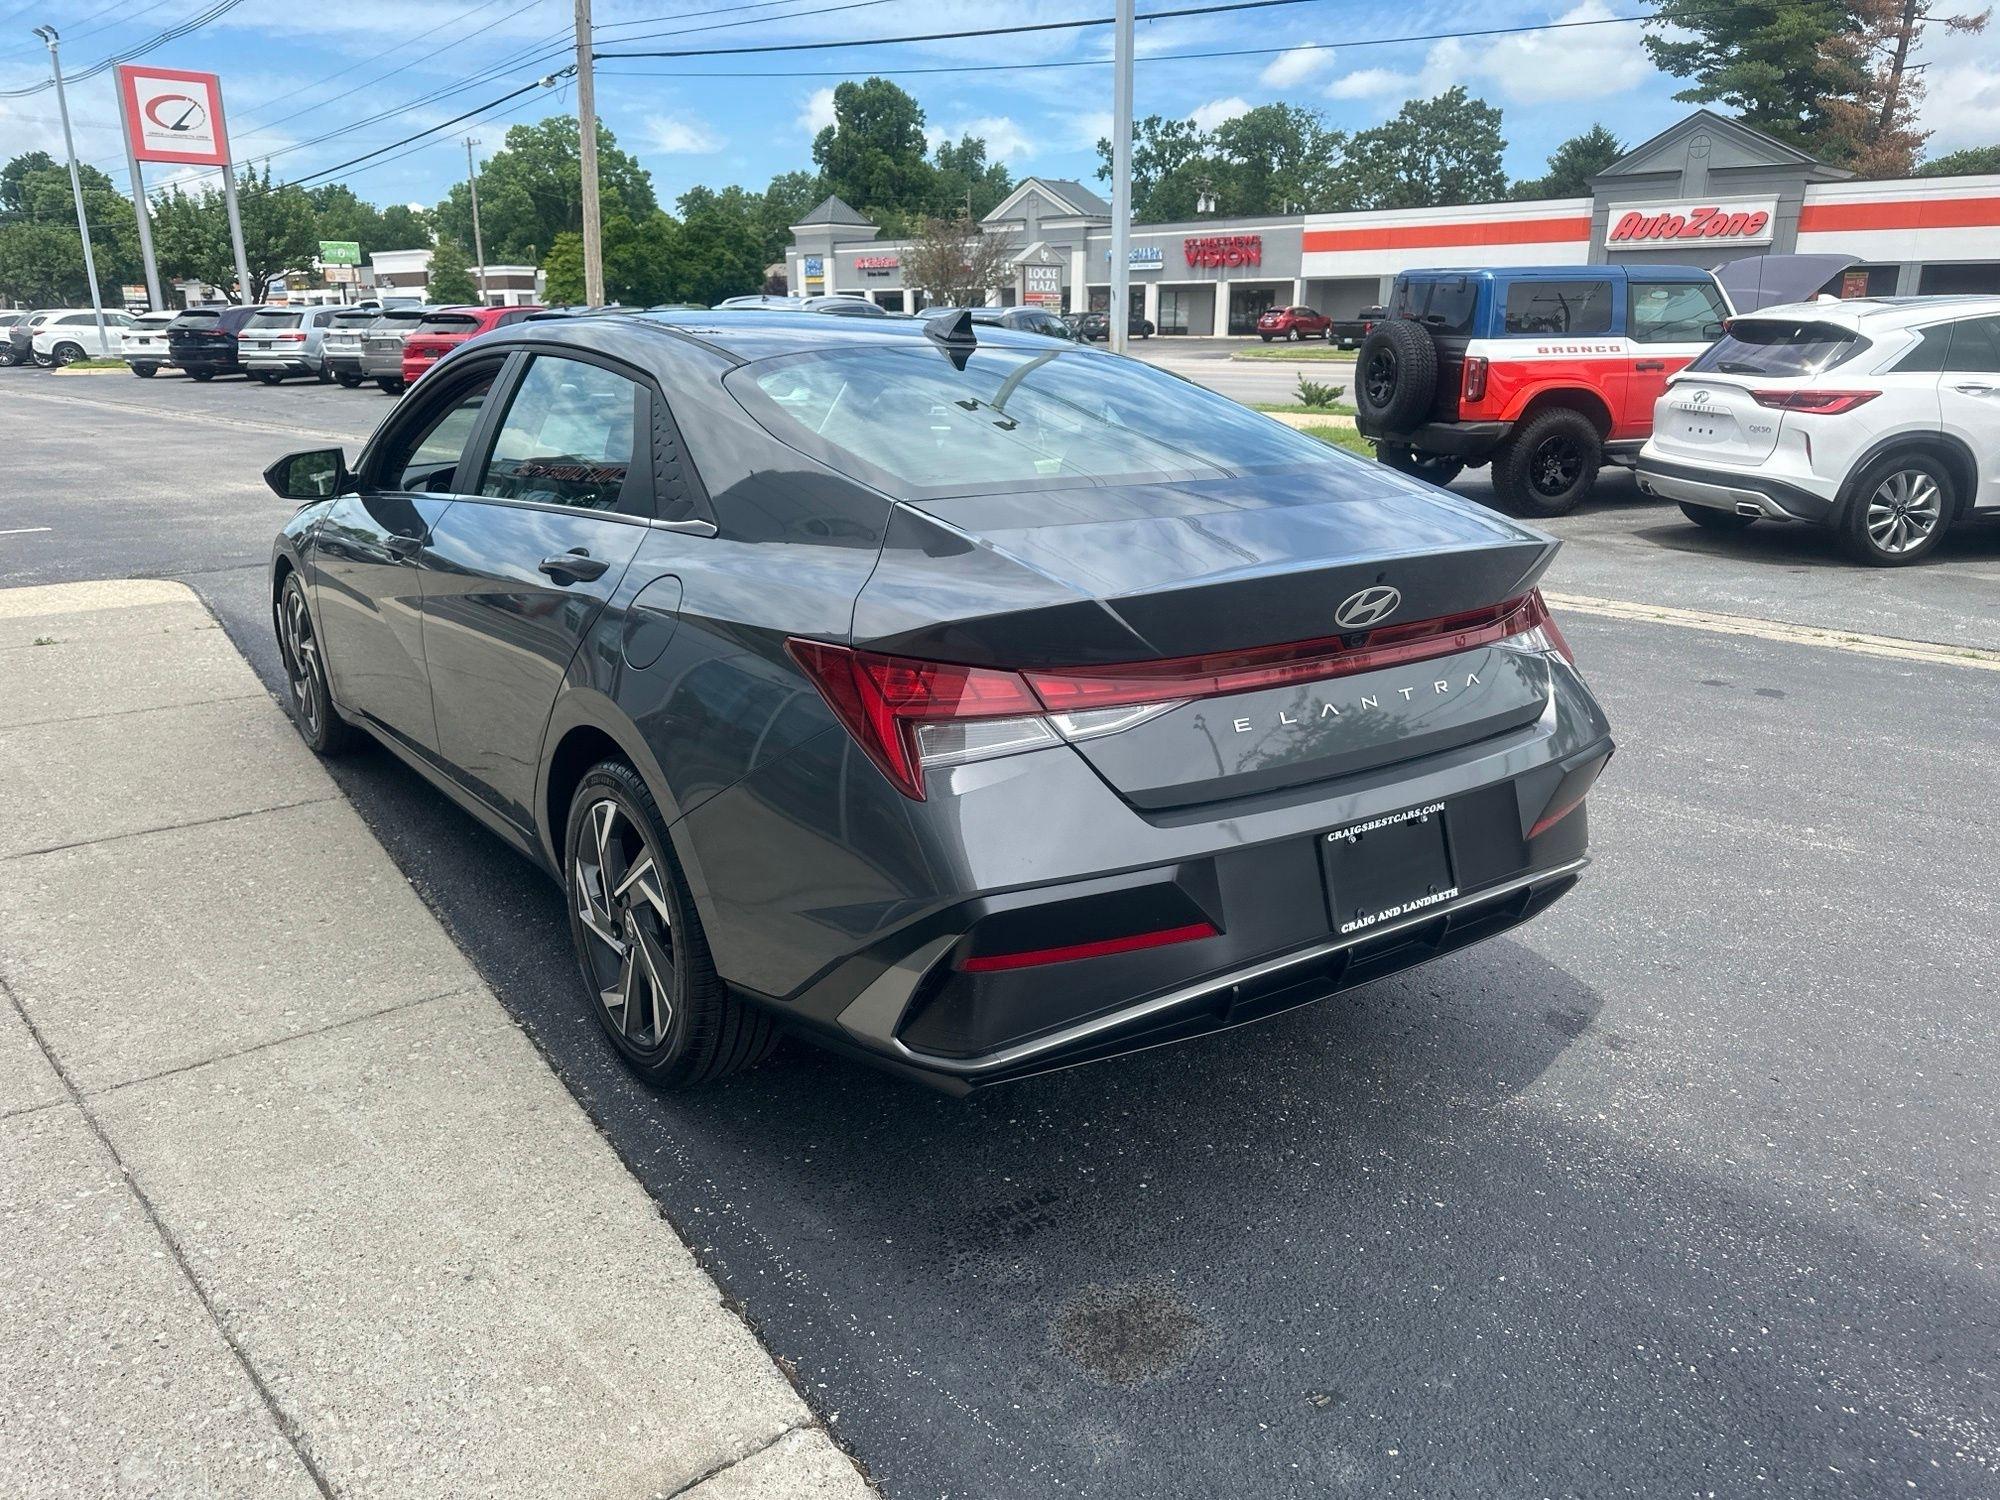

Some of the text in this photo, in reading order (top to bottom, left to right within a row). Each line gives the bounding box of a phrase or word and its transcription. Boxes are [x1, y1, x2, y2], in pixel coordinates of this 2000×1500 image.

[1609, 207, 1769, 241] AutoZone
[1184, 246, 1262, 268] VISION
[1028, 268, 1057, 279] LOCKE
[1029, 280, 1057, 292] PLAZA
[1537, 345, 1621, 354] BRONCO
[1749, 424, 1772, 434] QX50
[1233, 673, 1481, 733] ELANTRA
[1327, 802, 1446, 842] CRAIGSBESTCARS.COM
[1340, 887, 1459, 934] CRAIG AND LANDRETH
